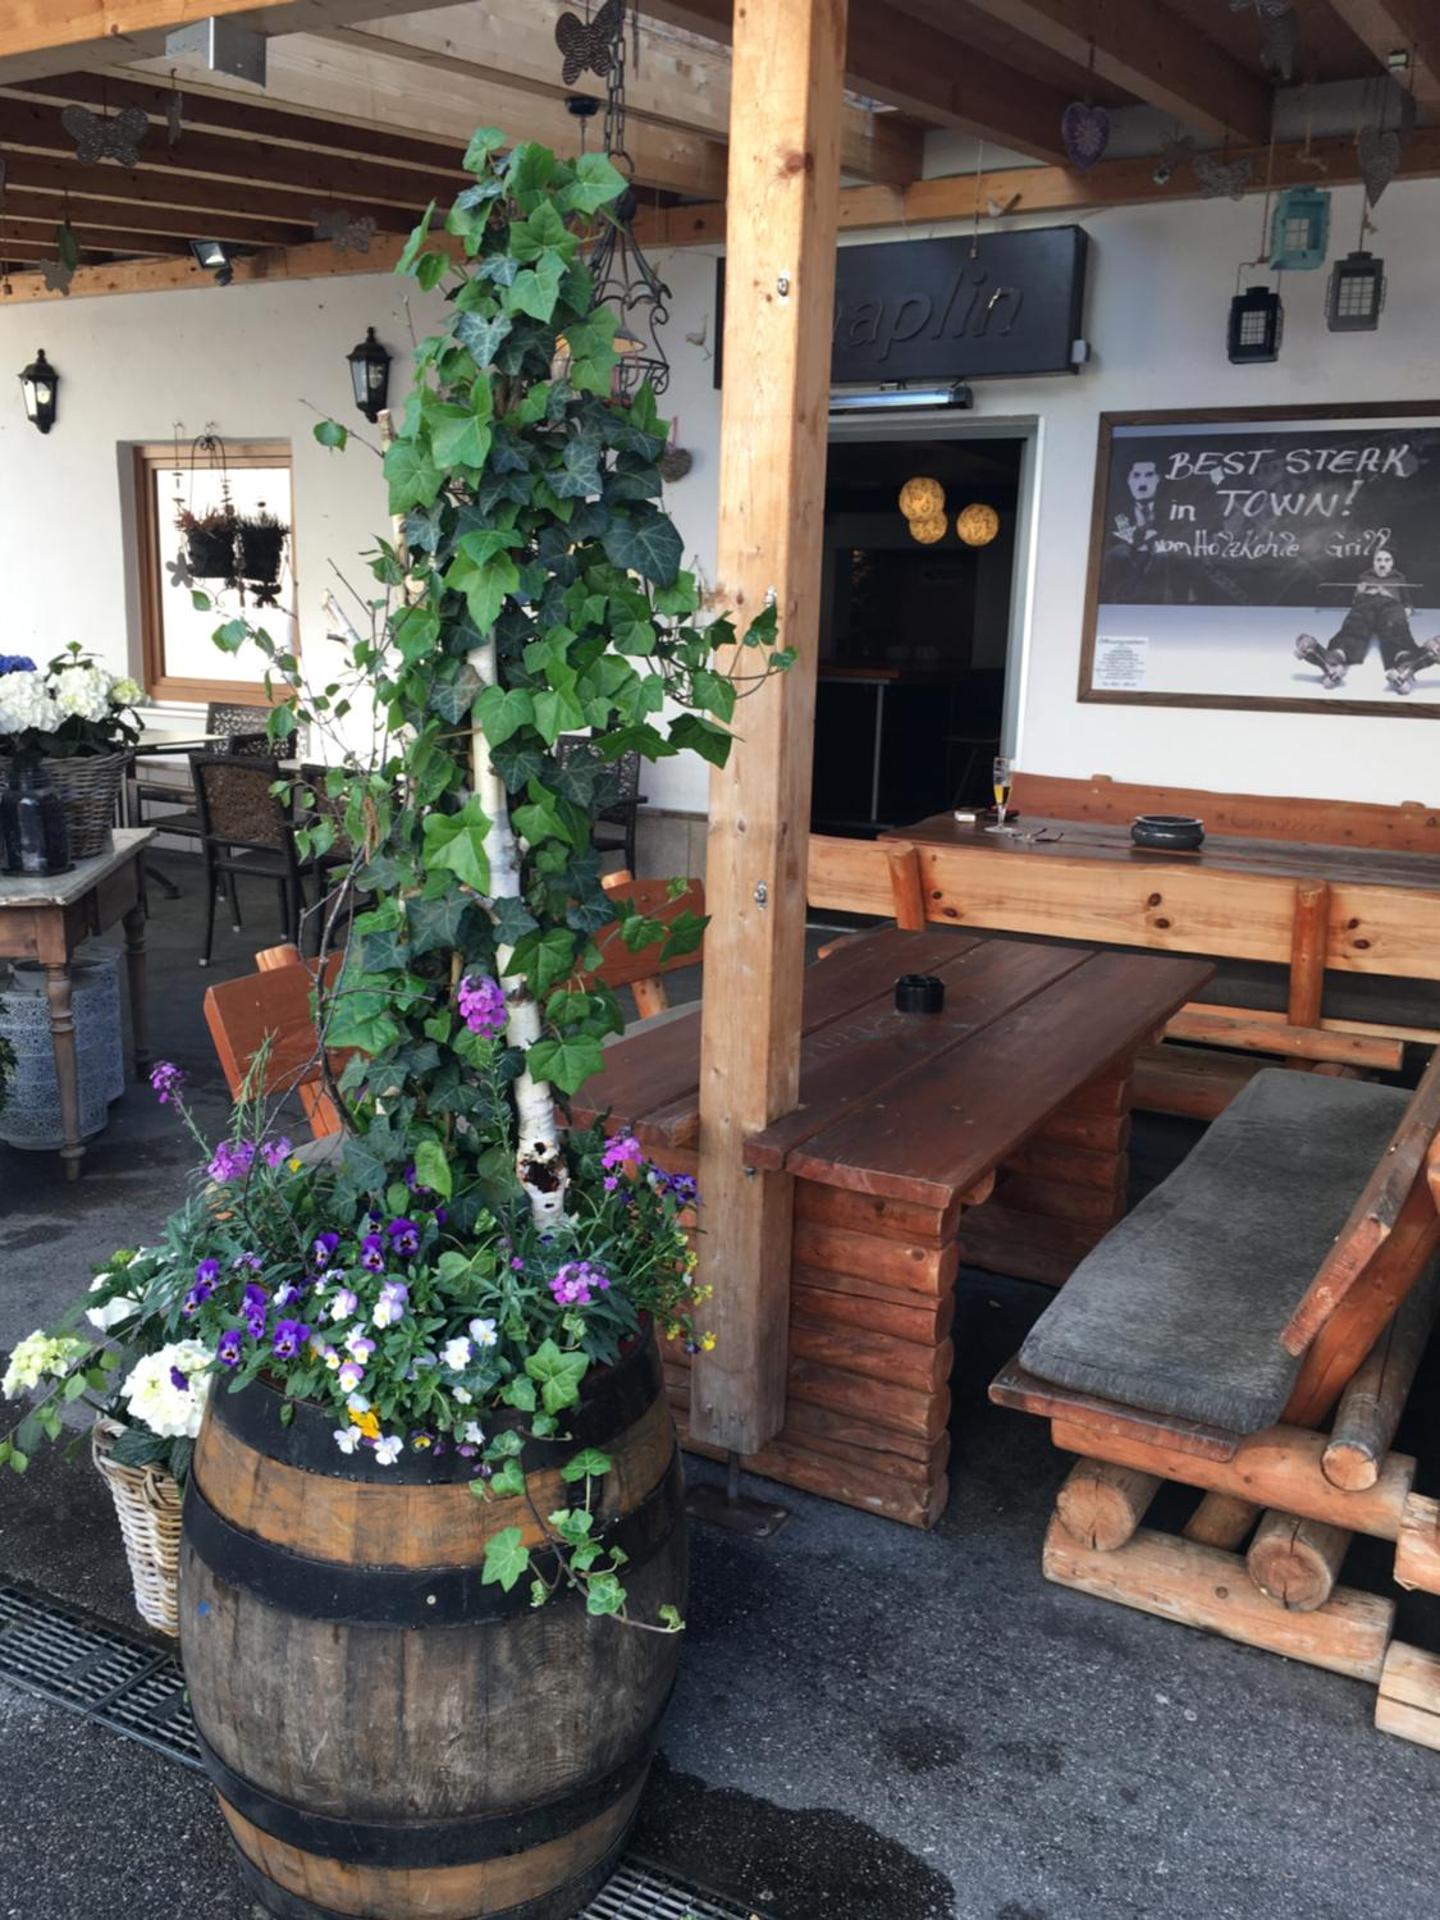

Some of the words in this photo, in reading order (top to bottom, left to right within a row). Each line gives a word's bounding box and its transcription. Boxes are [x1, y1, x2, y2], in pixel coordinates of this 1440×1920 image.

[834, 265, 1024, 363] aplin
[1165, 449, 1276, 480] BEST
[1285, 444, 1410, 478] STEAK
[1169, 499, 1196, 521] in
[1216, 480, 1364, 517] TOWN!
